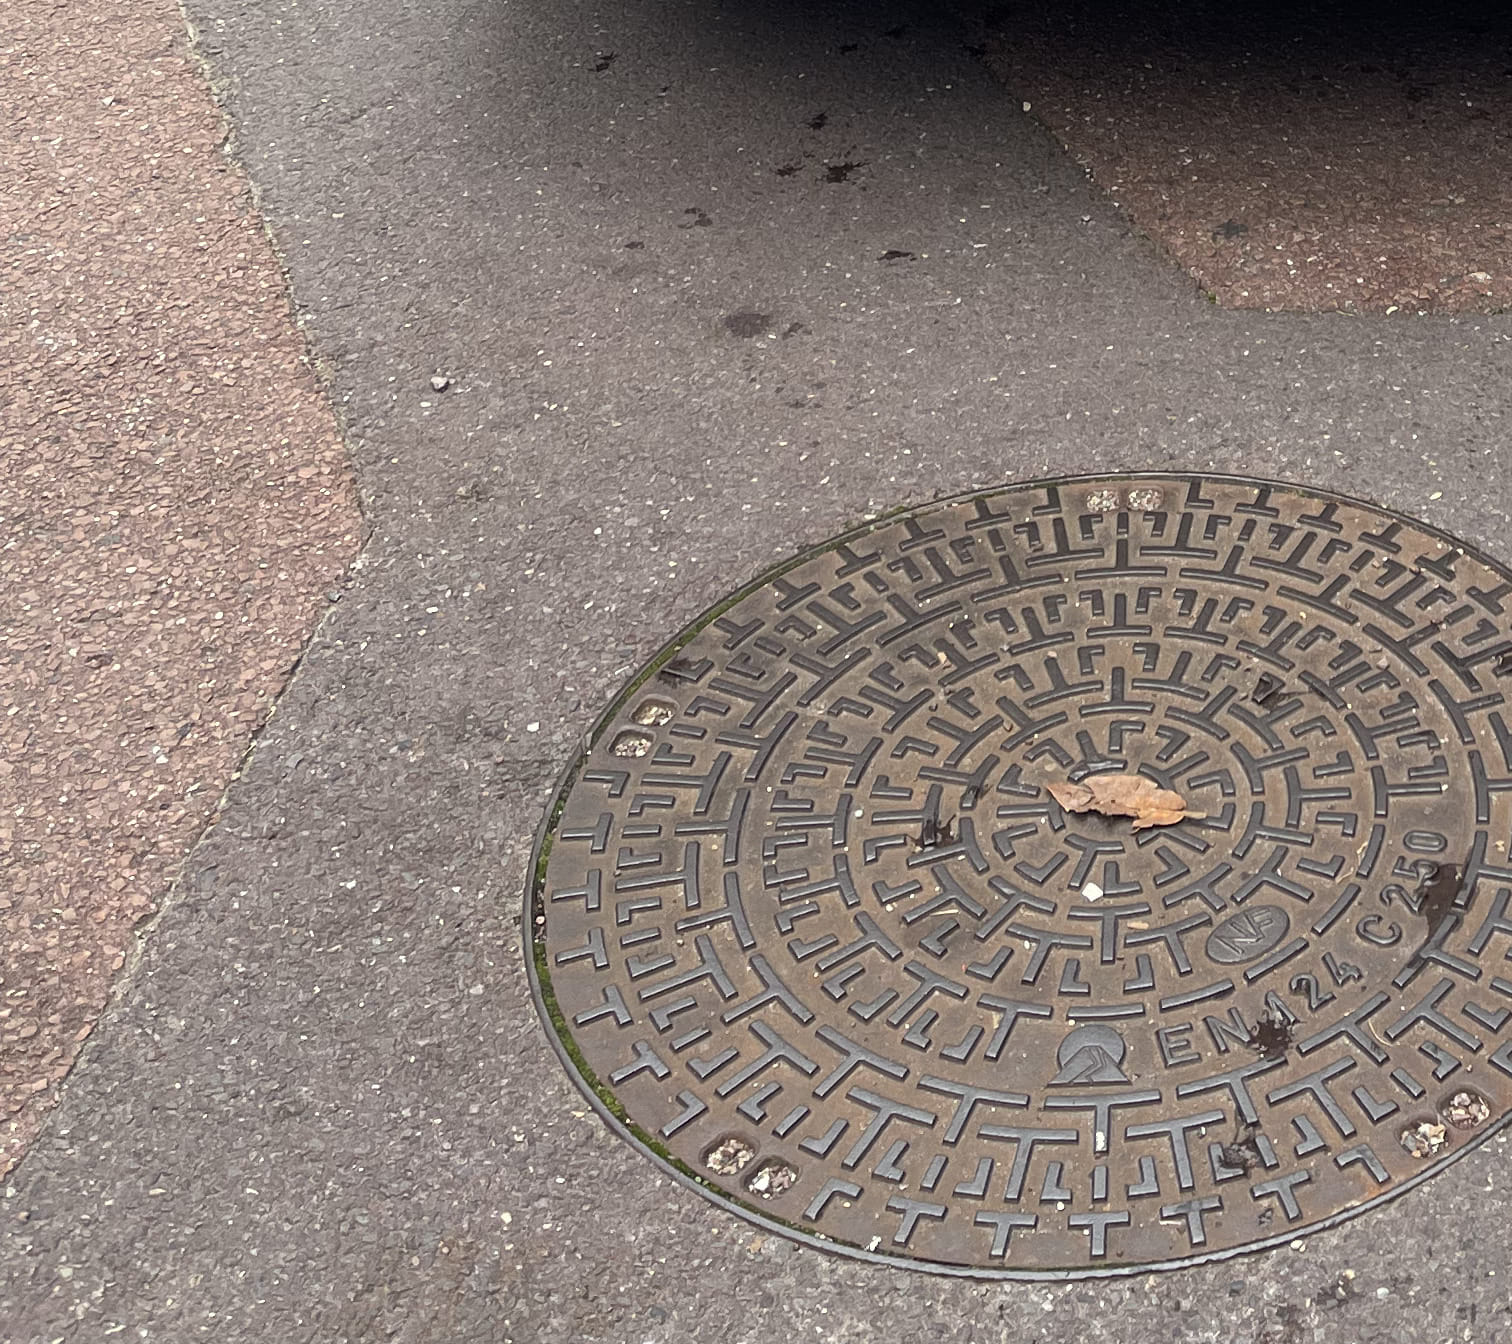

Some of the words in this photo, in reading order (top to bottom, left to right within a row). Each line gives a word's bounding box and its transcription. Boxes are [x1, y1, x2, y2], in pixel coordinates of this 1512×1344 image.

[1156, 1007, 1251, 1069] EN
[1356, 914, 1402, 948] C
[1380, 830, 1448, 913] 250
